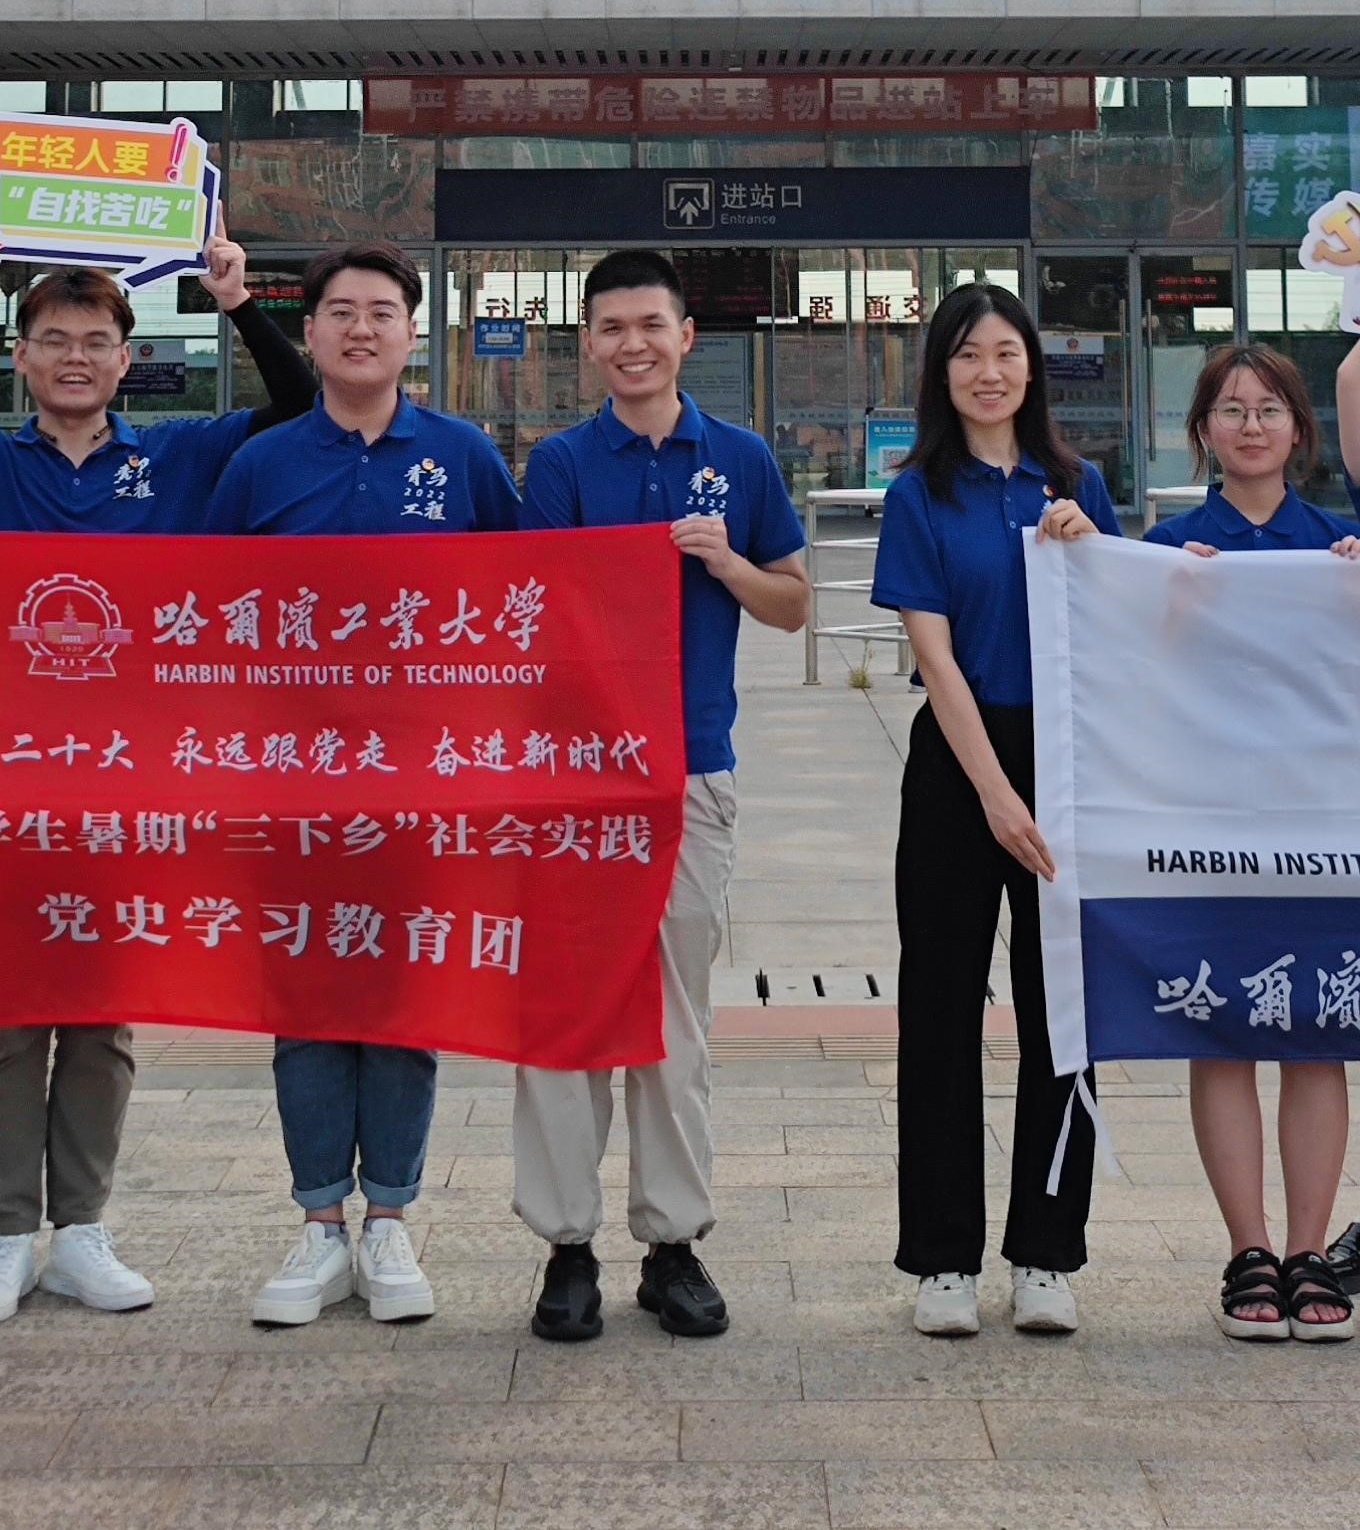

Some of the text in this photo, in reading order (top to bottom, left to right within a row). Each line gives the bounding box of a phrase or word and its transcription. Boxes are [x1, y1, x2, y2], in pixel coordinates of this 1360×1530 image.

[407, 84, 1059, 123] 严禁携带危险违禁物品进站上车
[0, 131, 150, 176] 年轻人要
[1243, 131, 1333, 172] 嘉实
[721, 182, 802, 209] 进站口
[1243, 176, 1335, 217] 传媒
[720, 212, 777, 225] Entrance
[404, 487, 445, 500] 2022
[686, 496, 727, 508] 2022
[400, 500, 446, 521] 工程
[52, 658, 91, 667] HIT
[154, 664, 546, 685] HARBIN INSTITUTE OF TECHNOLOGY
[170, 726, 398, 776] 永远跟党走
[426, 726, 650, 777] 奋进新时代
[1147, 848, 1259, 874] HARBIN
[38, 892, 524, 976] 党史学习教育团
